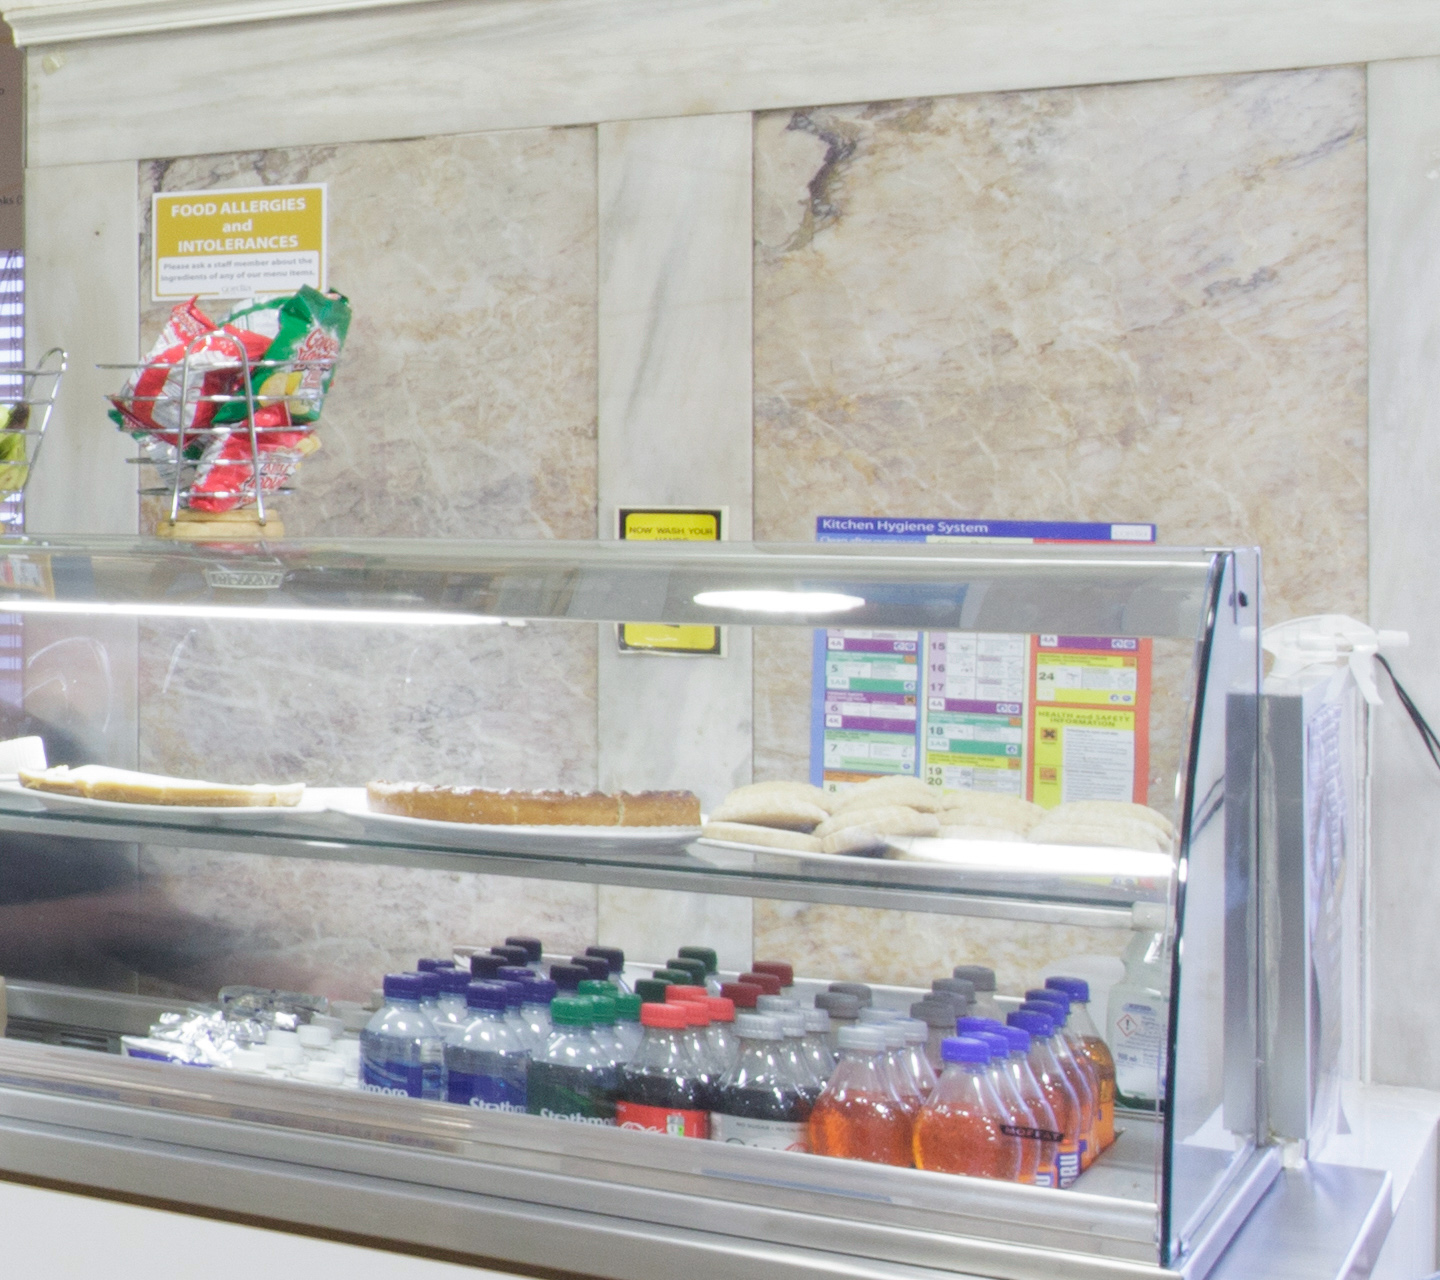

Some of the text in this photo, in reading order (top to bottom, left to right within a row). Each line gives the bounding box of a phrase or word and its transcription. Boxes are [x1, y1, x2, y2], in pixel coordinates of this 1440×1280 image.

[171, 198, 306, 217] FOOD ALLERGIES
[222, 219, 252, 233] and
[178, 236, 298, 252] INTOLERANCES
[161, 274, 207, 282] ingredients
[823, 519, 988, 533] Kitchen Hygiene System
[1039, 672, 1054, 680] 24
[931, 683, 943, 691] 17
[1050, 718, 1115, 727] INFORMATION
[929, 727, 943, 735] 18
[928, 767, 942, 775] 19
